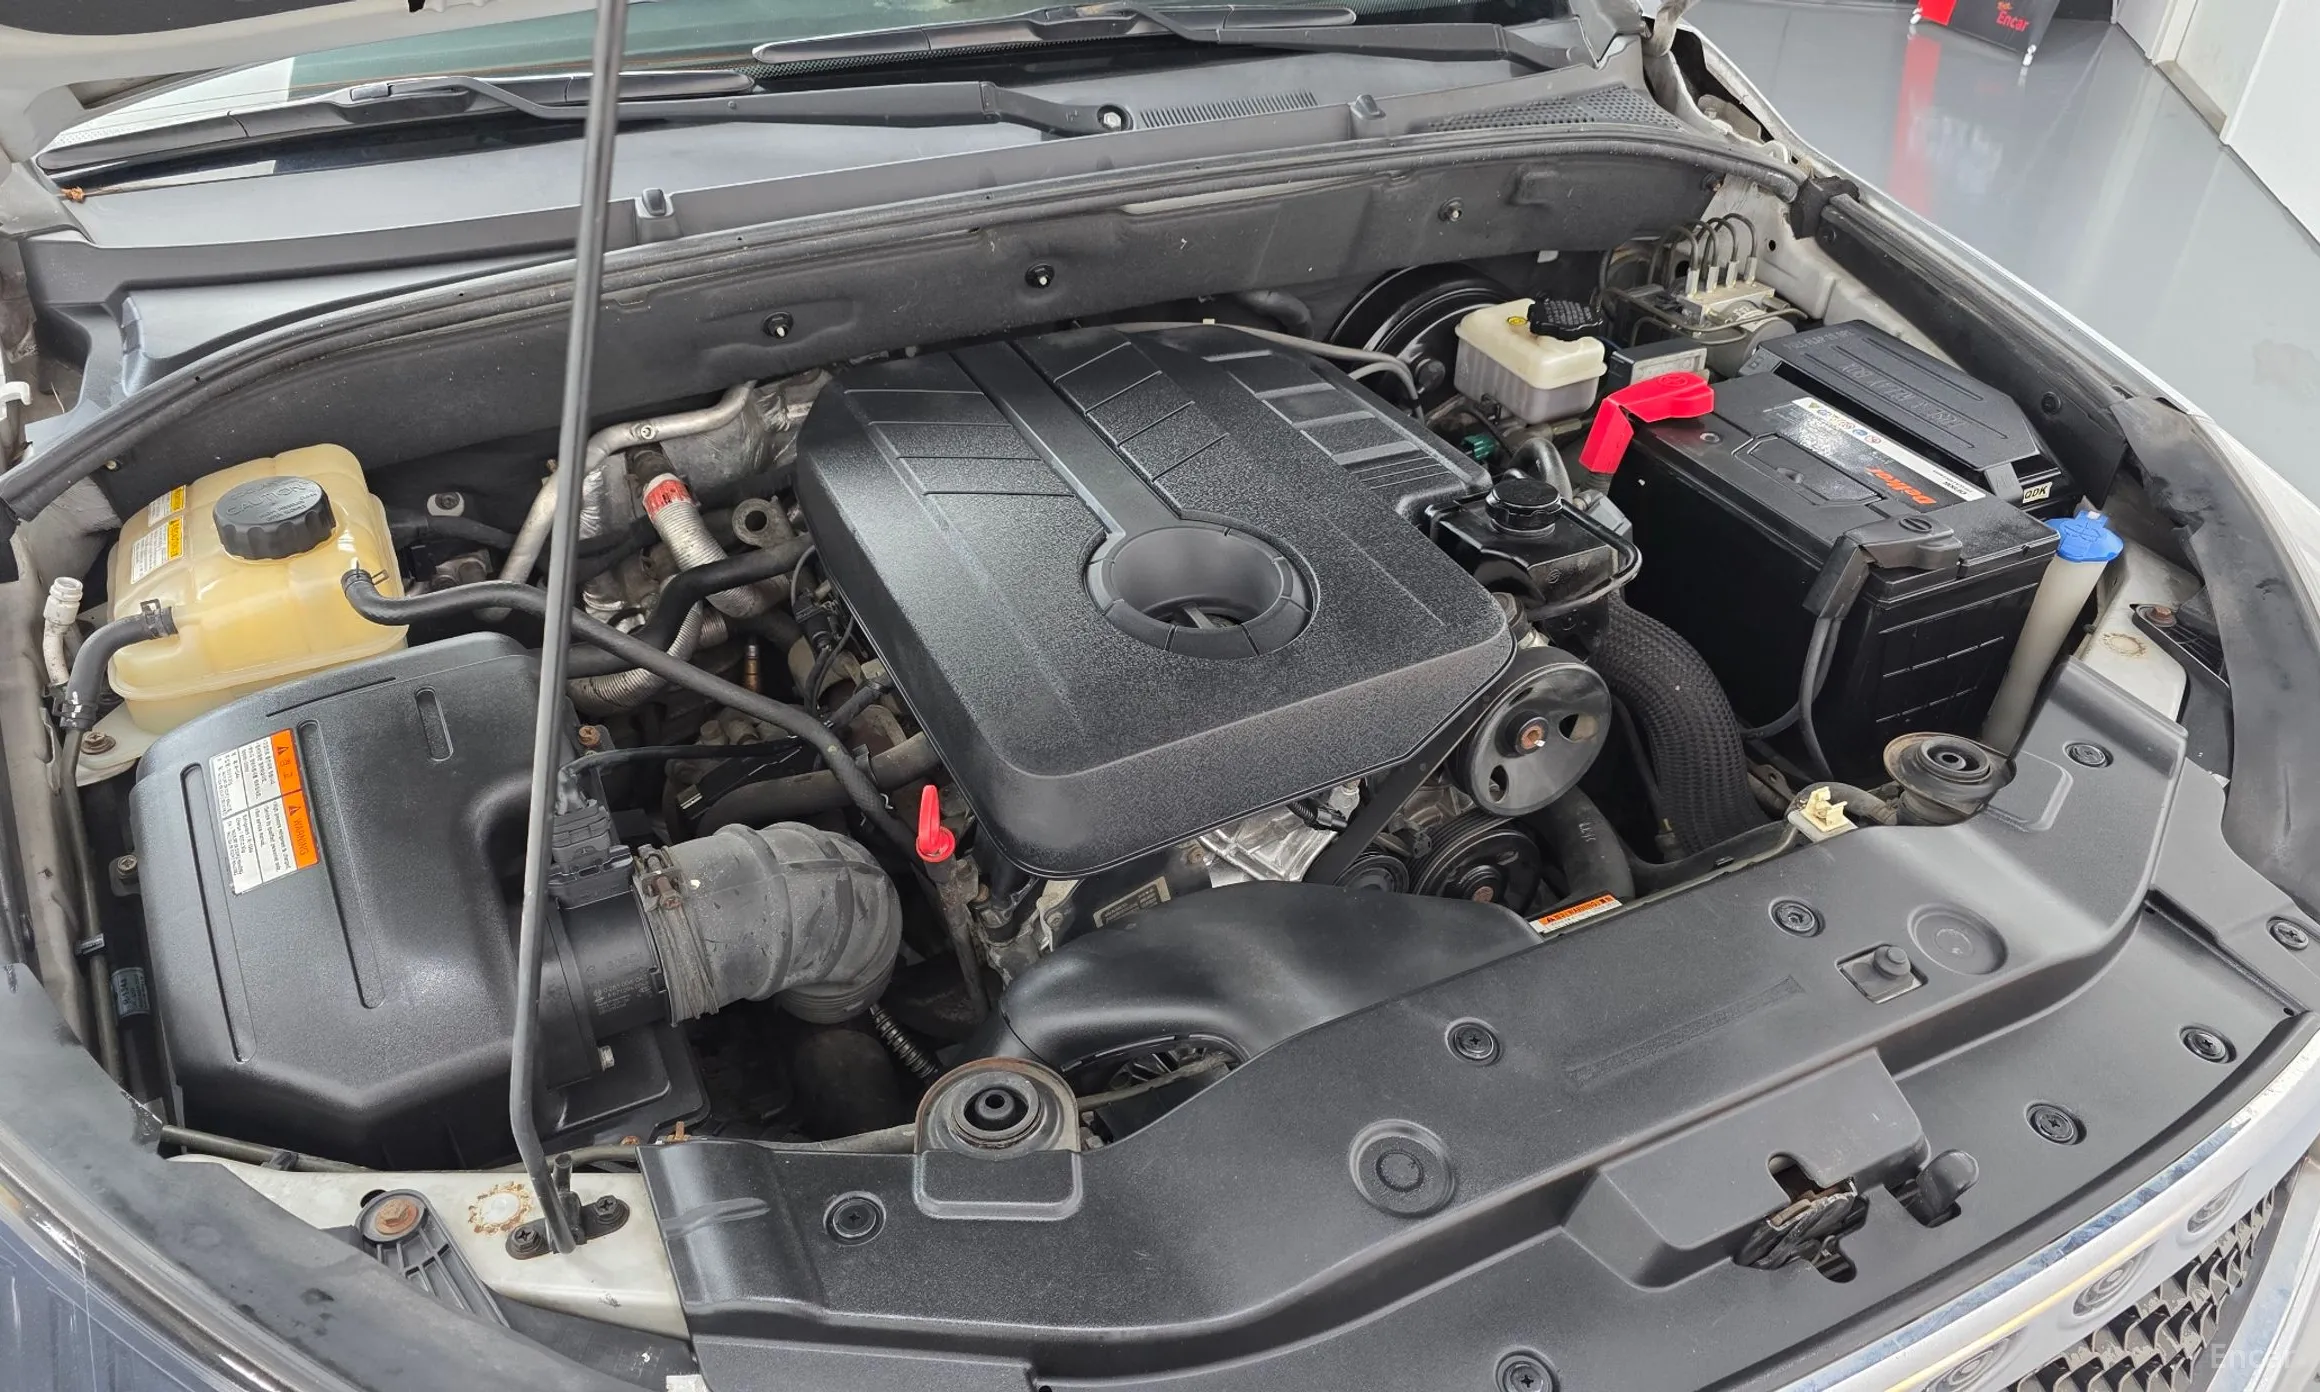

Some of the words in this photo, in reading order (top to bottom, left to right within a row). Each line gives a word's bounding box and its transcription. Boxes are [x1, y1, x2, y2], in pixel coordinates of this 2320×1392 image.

[1996, 11, 2030, 32] Encar
[225, 484, 307, 516] CAUTION
[2024, 486, 2048, 499] QDK
[293, 817, 309, 856] WARNING
